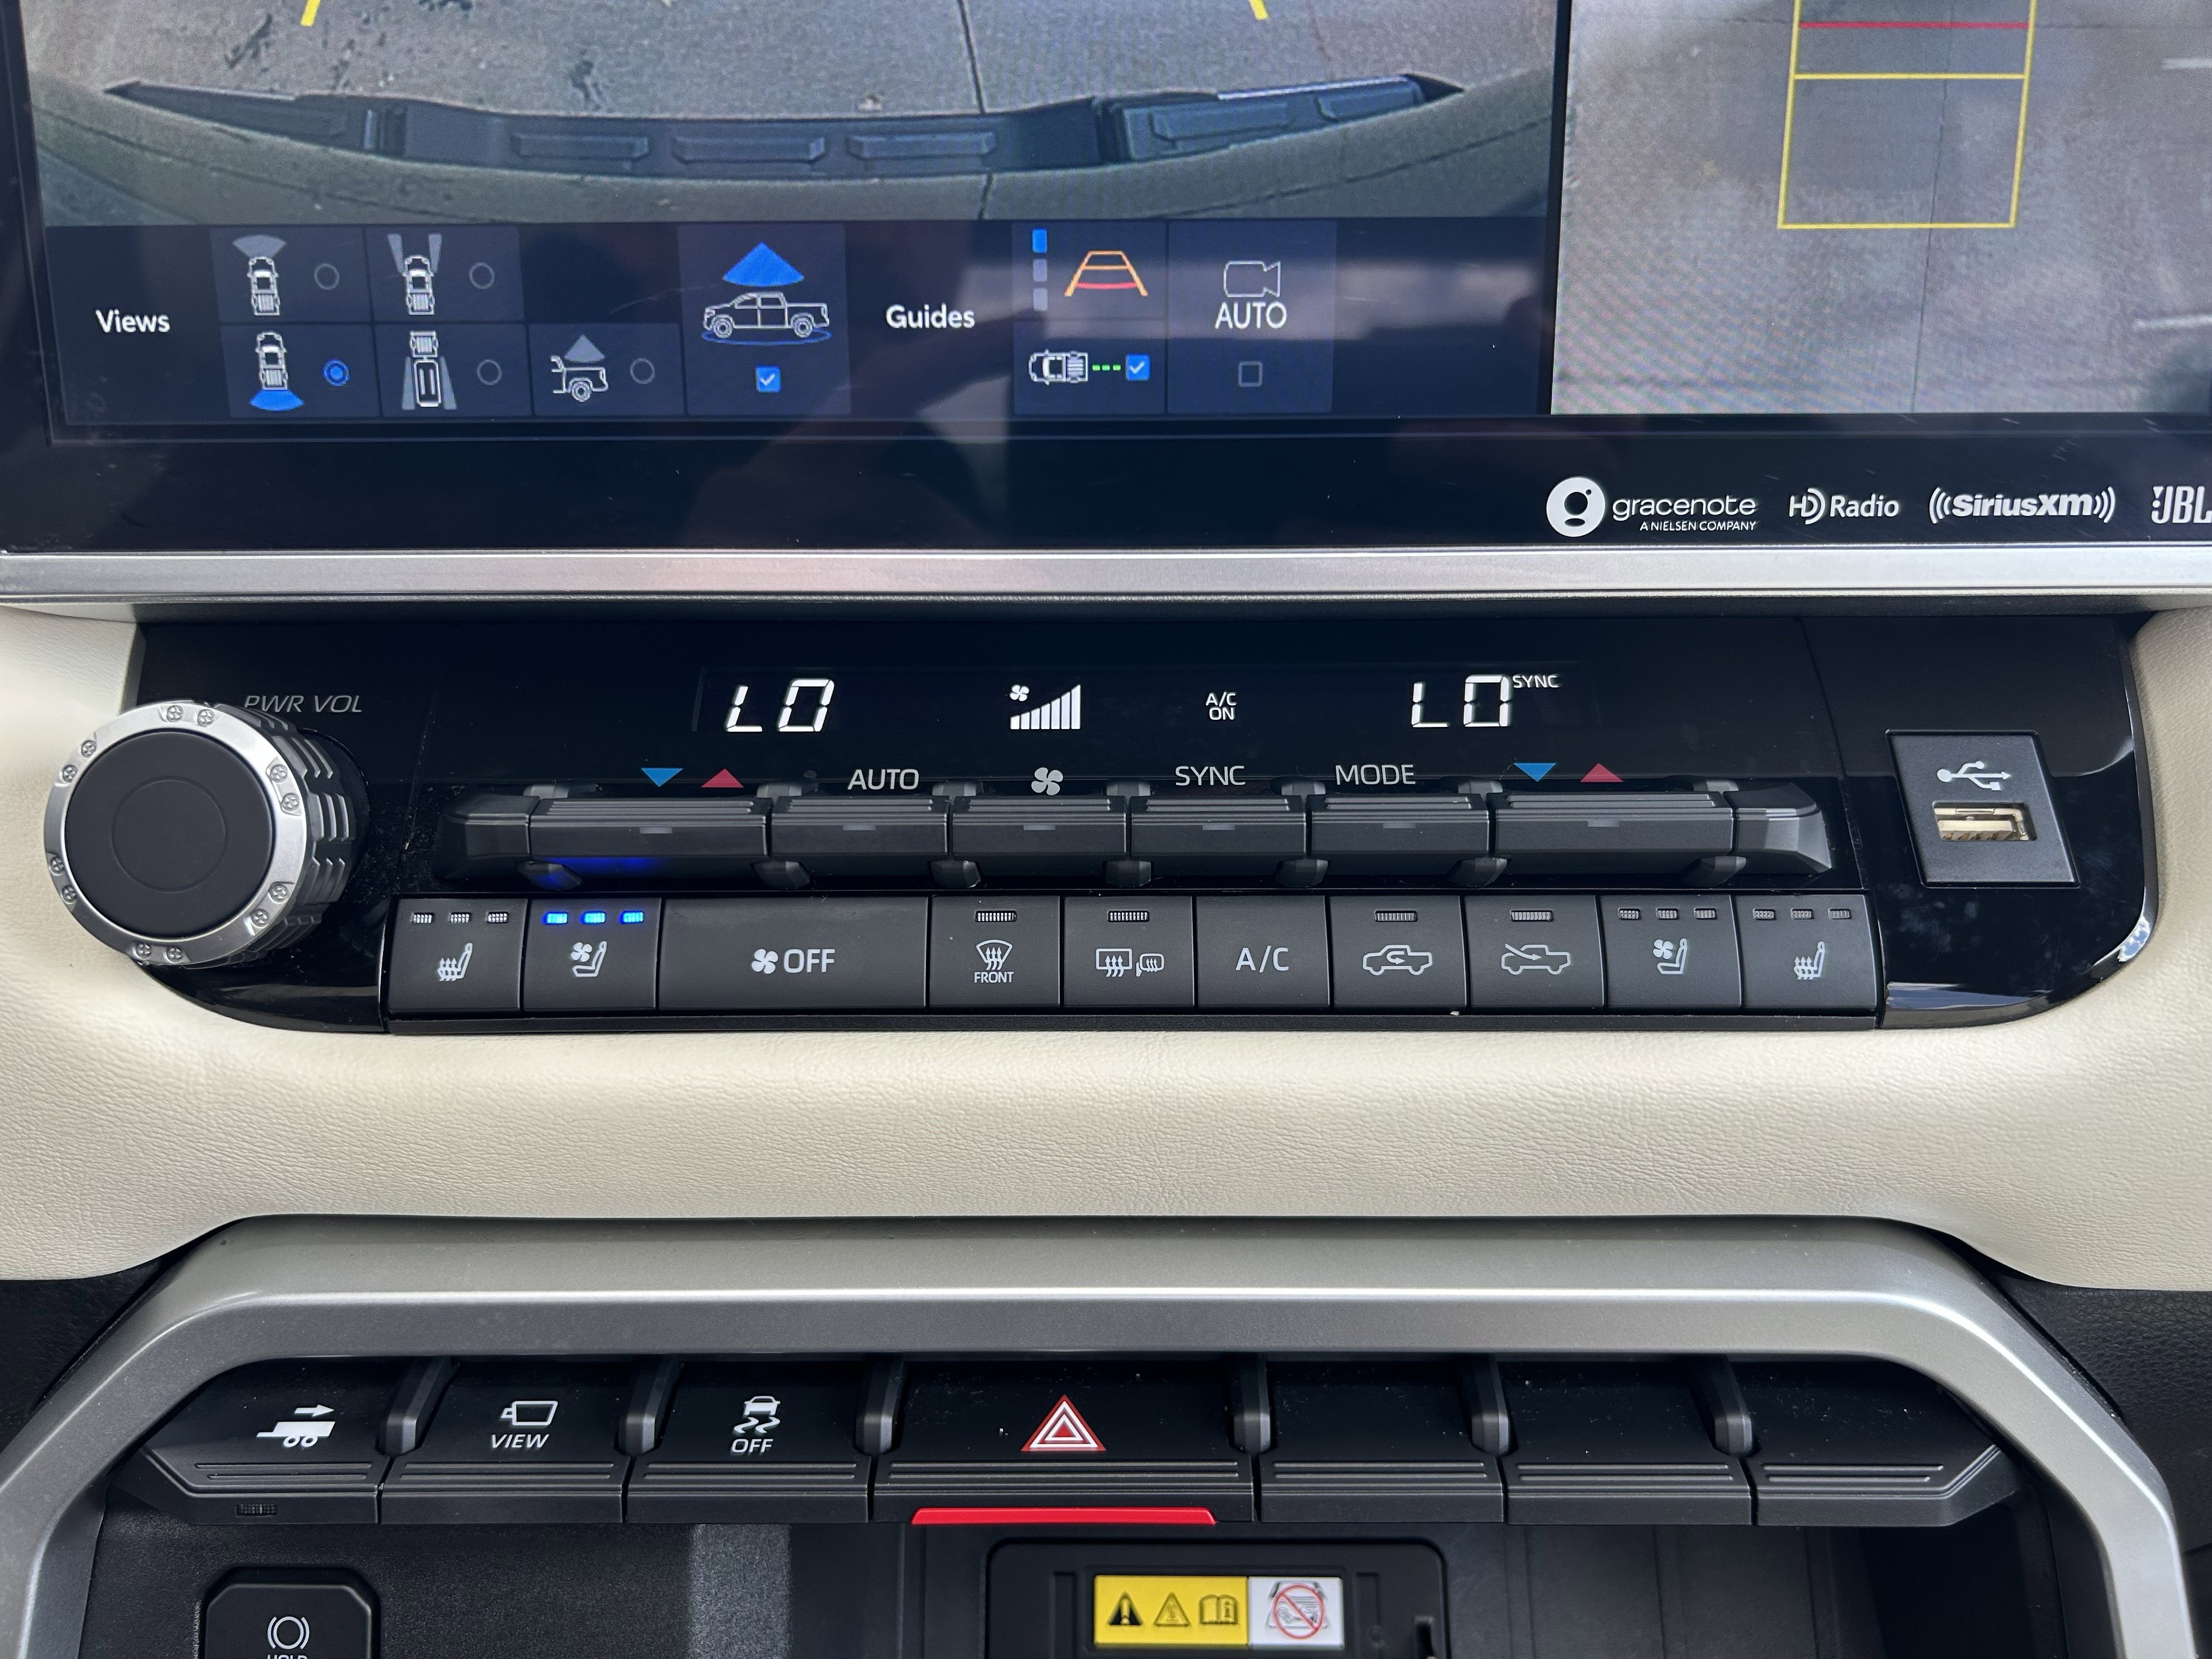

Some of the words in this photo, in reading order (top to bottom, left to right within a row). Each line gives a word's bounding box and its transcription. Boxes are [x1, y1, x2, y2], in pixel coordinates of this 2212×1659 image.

[95, 308, 171, 333] Views
[885, 303, 976, 329] Guides
[1214, 301, 1288, 330] AUTO
[1612, 495, 1757, 521] gracenote
[1788, 488, 1826, 525] HD
[1830, 493, 1900, 518] Radio
[2151, 486, 2212, 524] JBL
[1639, 521, 1649, 531] A
[1650, 521, 1696, 531] NIELSEN
[1699, 521, 1757, 531] COMPANY
[1511, 674, 1560, 689] SYNC
[245, 695, 304, 713] PWR
[314, 695, 363, 713] VOL
[1205, 691, 1237, 707] A/C
[1209, 707, 1234, 720] ON
[847, 768, 920, 791] AUTO
[1175, 765, 1246, 787] SYNC
[1335, 764, 1417, 786] MODE
[783, 948, 836, 974] OFF
[1234, 945, 1290, 973] A/C
[973, 971, 1015, 984] FRONT
[491, 1434, 550, 1449] VIEW
[731, 1438, 774, 1453] OFF
